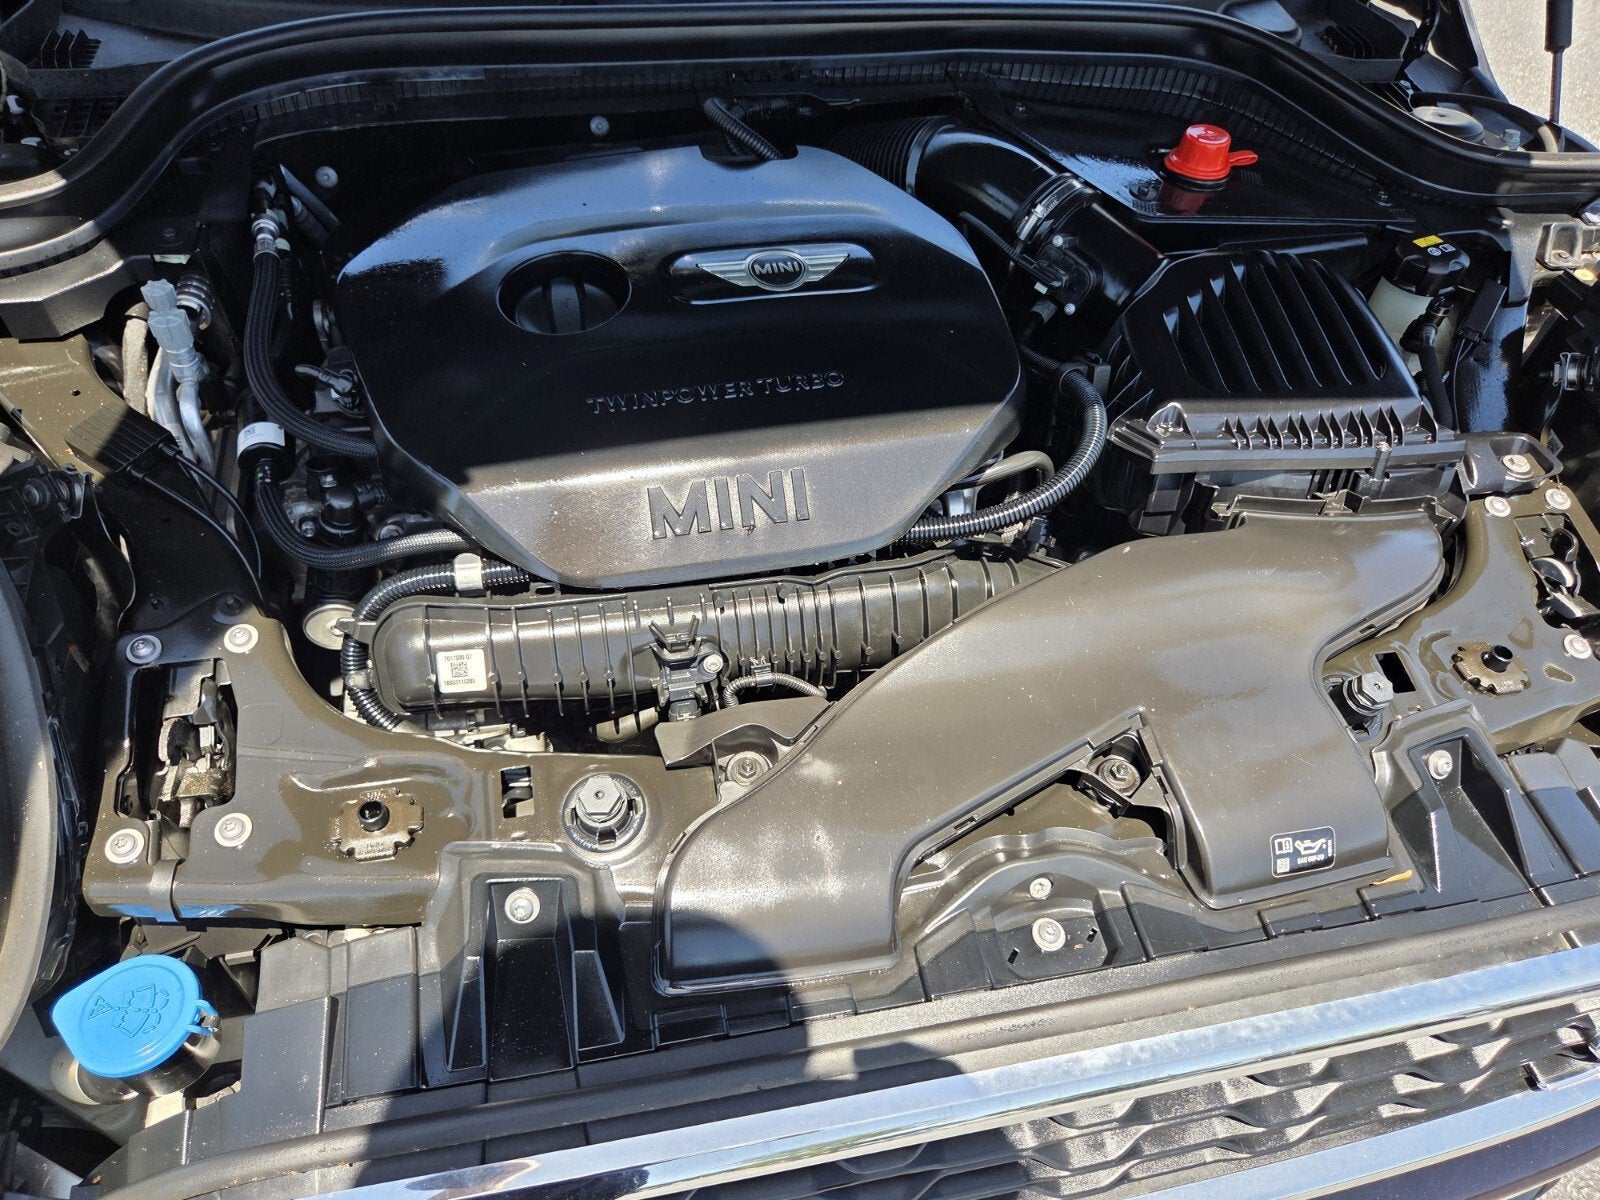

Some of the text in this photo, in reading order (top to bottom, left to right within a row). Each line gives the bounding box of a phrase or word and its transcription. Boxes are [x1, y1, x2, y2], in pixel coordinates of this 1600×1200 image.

[753, 261, 800, 275] MINI
[586, 370, 845, 414] TWINPOWER TURBO
[647, 467, 810, 540] MINI
